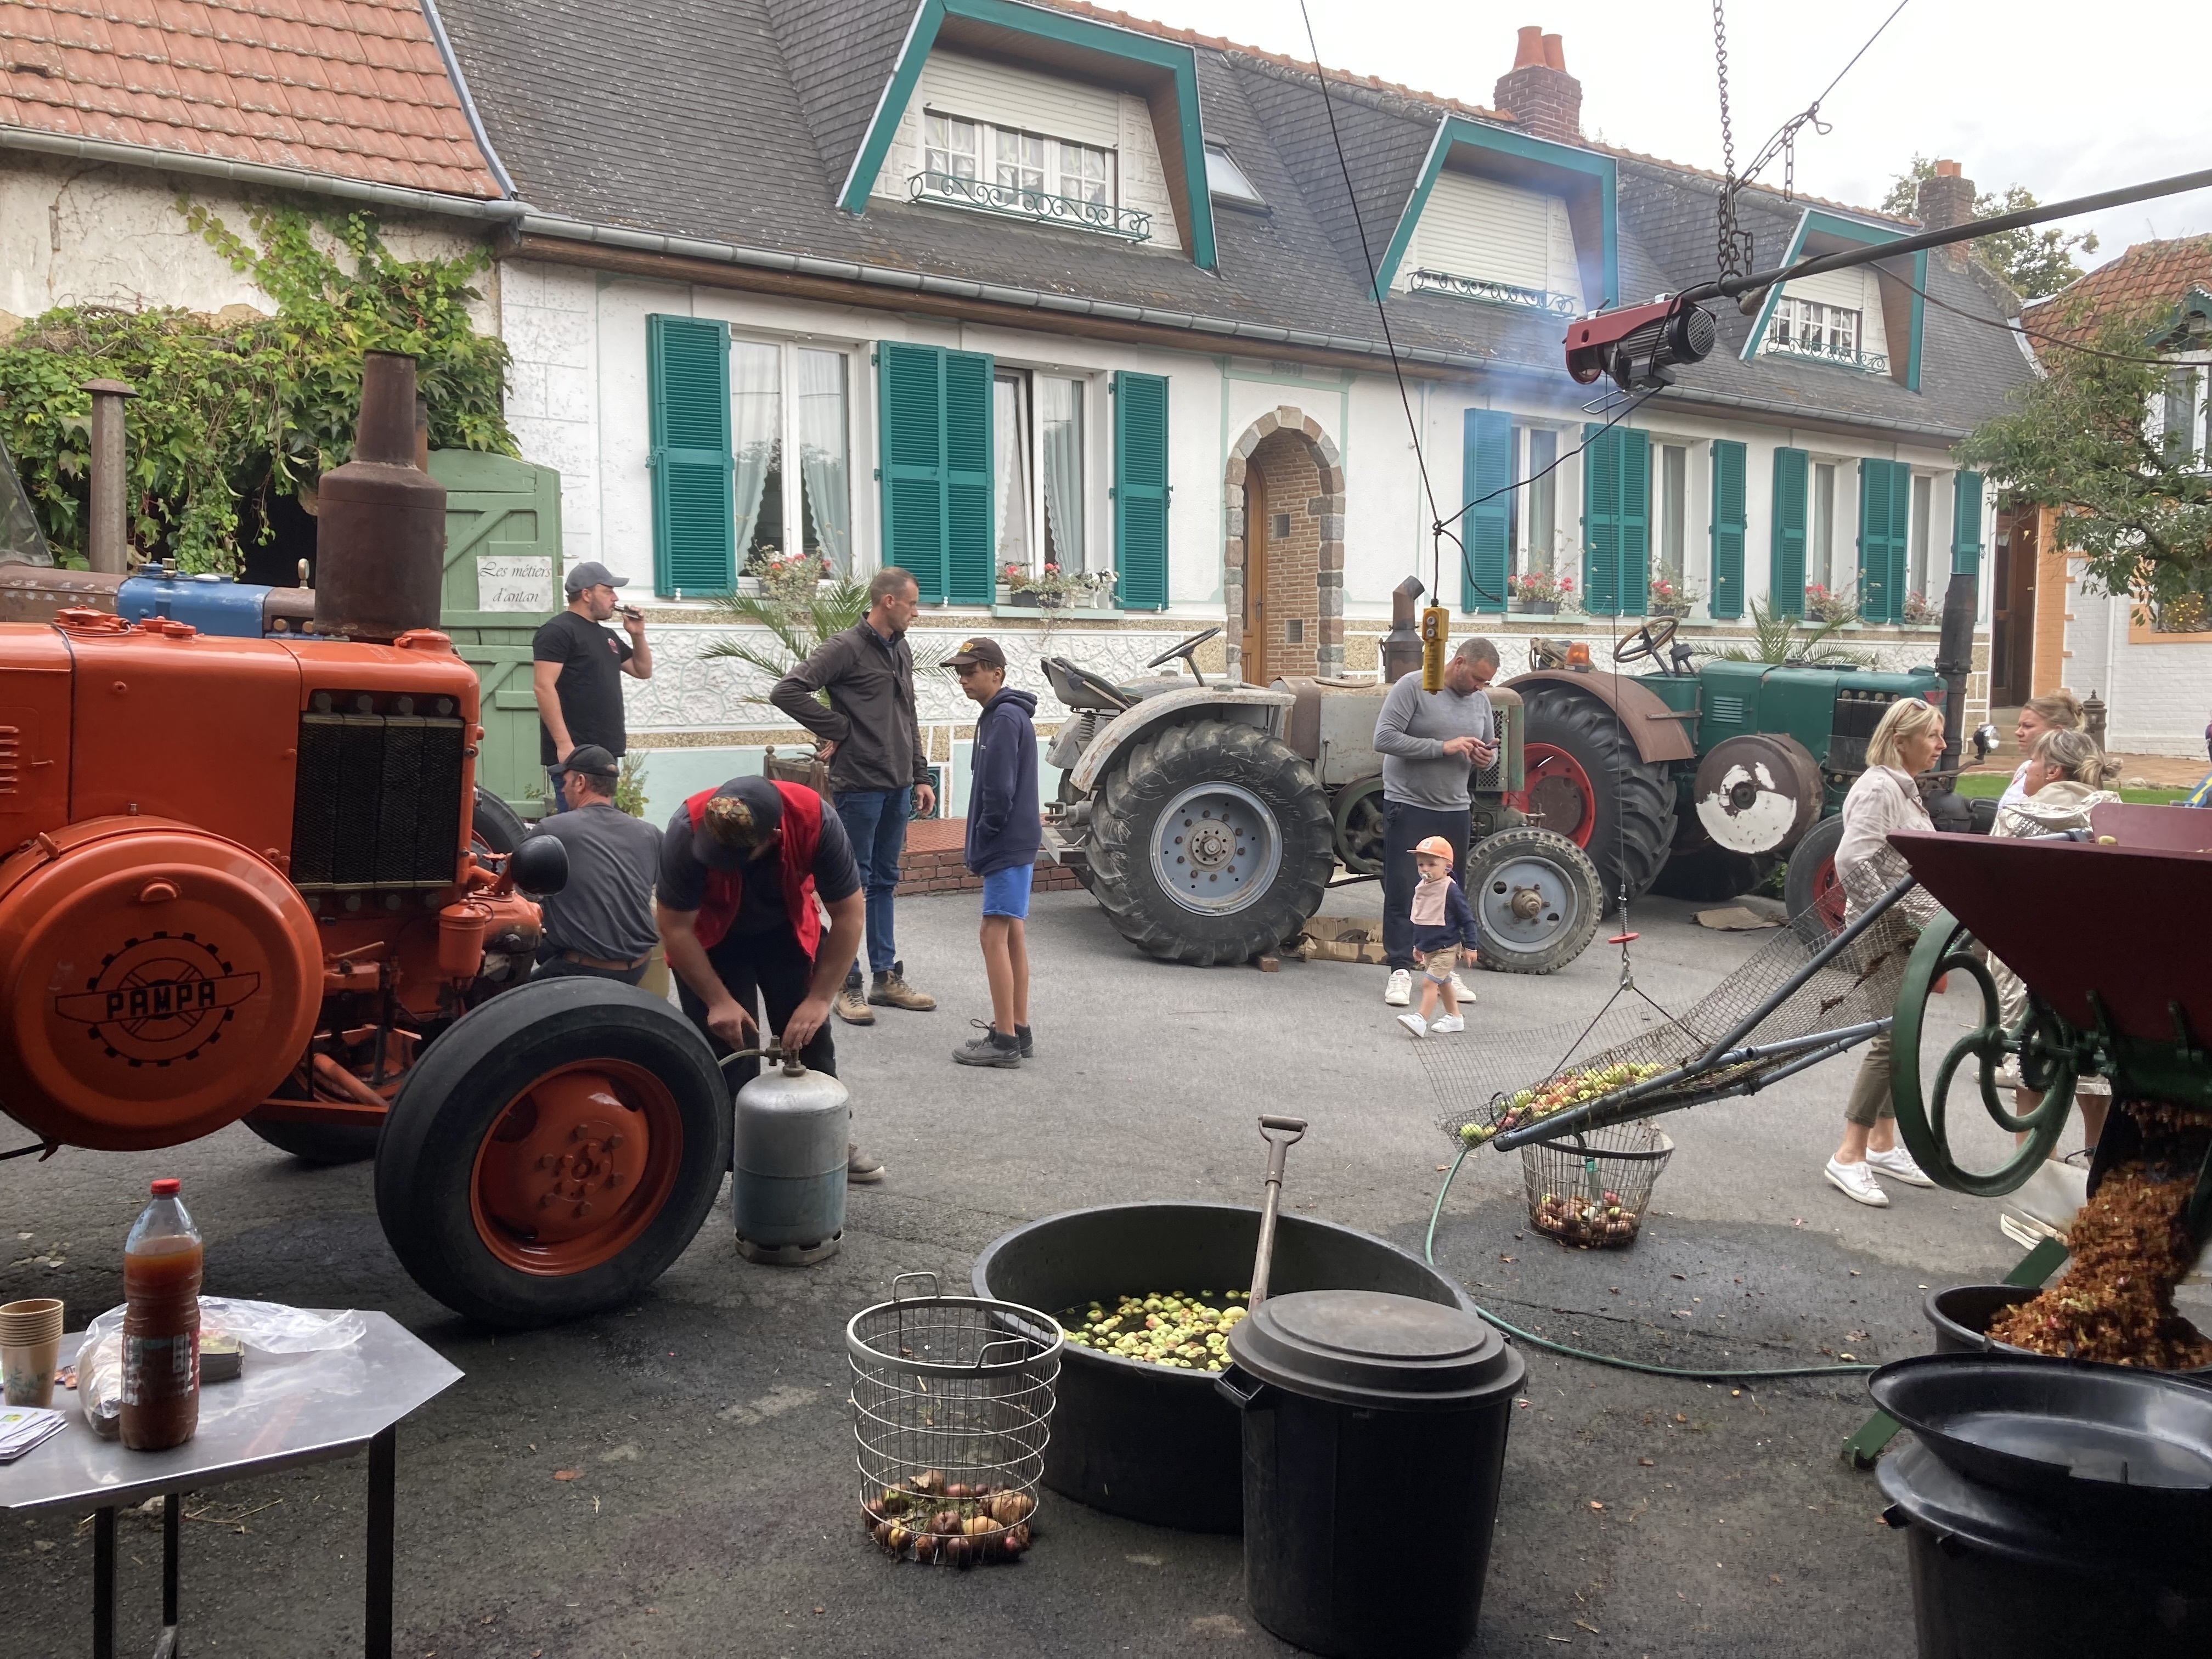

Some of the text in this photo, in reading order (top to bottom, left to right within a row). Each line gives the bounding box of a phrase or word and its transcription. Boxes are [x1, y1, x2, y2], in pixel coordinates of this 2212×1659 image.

[479, 562, 551, 577] Les métiers
[493, 588, 539, 602] d'antan
[106, 981, 215, 1019] PAMPA
